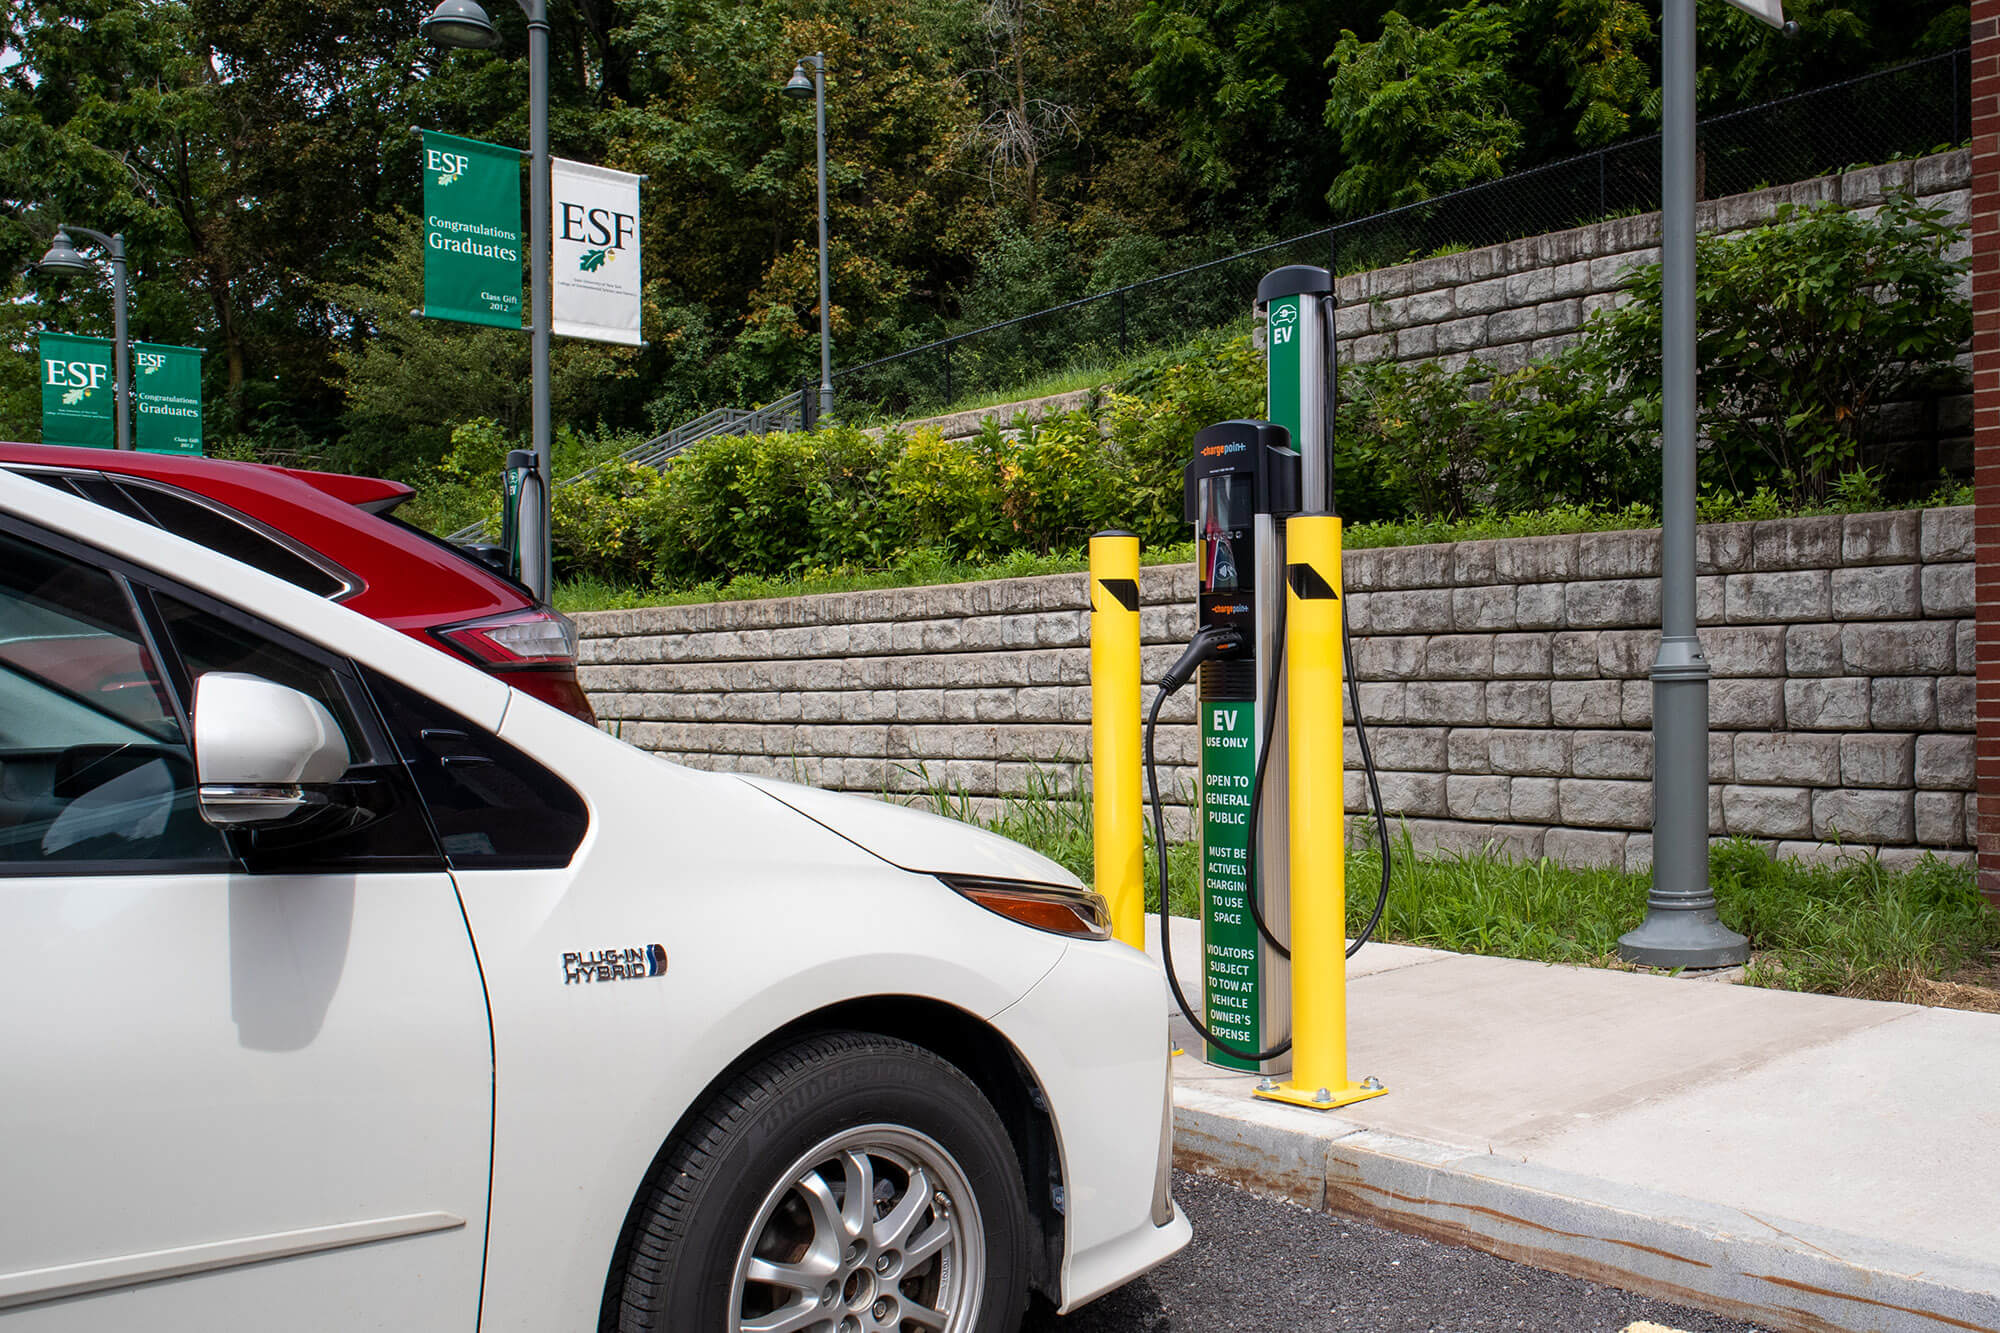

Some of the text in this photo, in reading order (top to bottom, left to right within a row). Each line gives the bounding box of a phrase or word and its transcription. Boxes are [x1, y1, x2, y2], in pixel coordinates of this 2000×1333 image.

[427, 149, 469, 176] ESF
[429, 216, 516, 240] Congratulations
[559, 201, 635, 250] ESF
[429, 232, 517, 262] Graduates
[481, 291, 501, 301] Class
[490, 303, 509, 312] 2012
[1274, 326, 1292, 345] EV
[137, 353, 166, 368] ESF
[44, 359, 107, 389] ESF
[139, 402, 198, 417] Graduates
[1213, 710, 1238, 731] EV
[1206, 737, 1248, 748] USE ONLY
[1206, 774, 1249, 788] OPEN TO
[1206, 792, 1251, 806] GENERAL
[1209, 811, 1245, 825] PUBLIC
[1209, 846, 1247, 859] MUST BE
[1206, 878, 1247, 892] CHARGIN
[1212, 895, 1244, 909] TO USE
[1214, 911, 1241, 925] SPACE
[563, 947, 645, 969] PLUG-IN
[1206, 943, 1255, 960] VIOLATORS
[564, 963, 646, 985] HYBRID
[1210, 961, 1249, 976] SUBJECT
[1208, 976, 1254, 993] TO TOW AT
[1211, 993, 1248, 1009] VEHICLE
[1210, 1009, 1251, 1025] OWNER'S
[1211, 1025, 1251, 1042] EXPENSE
